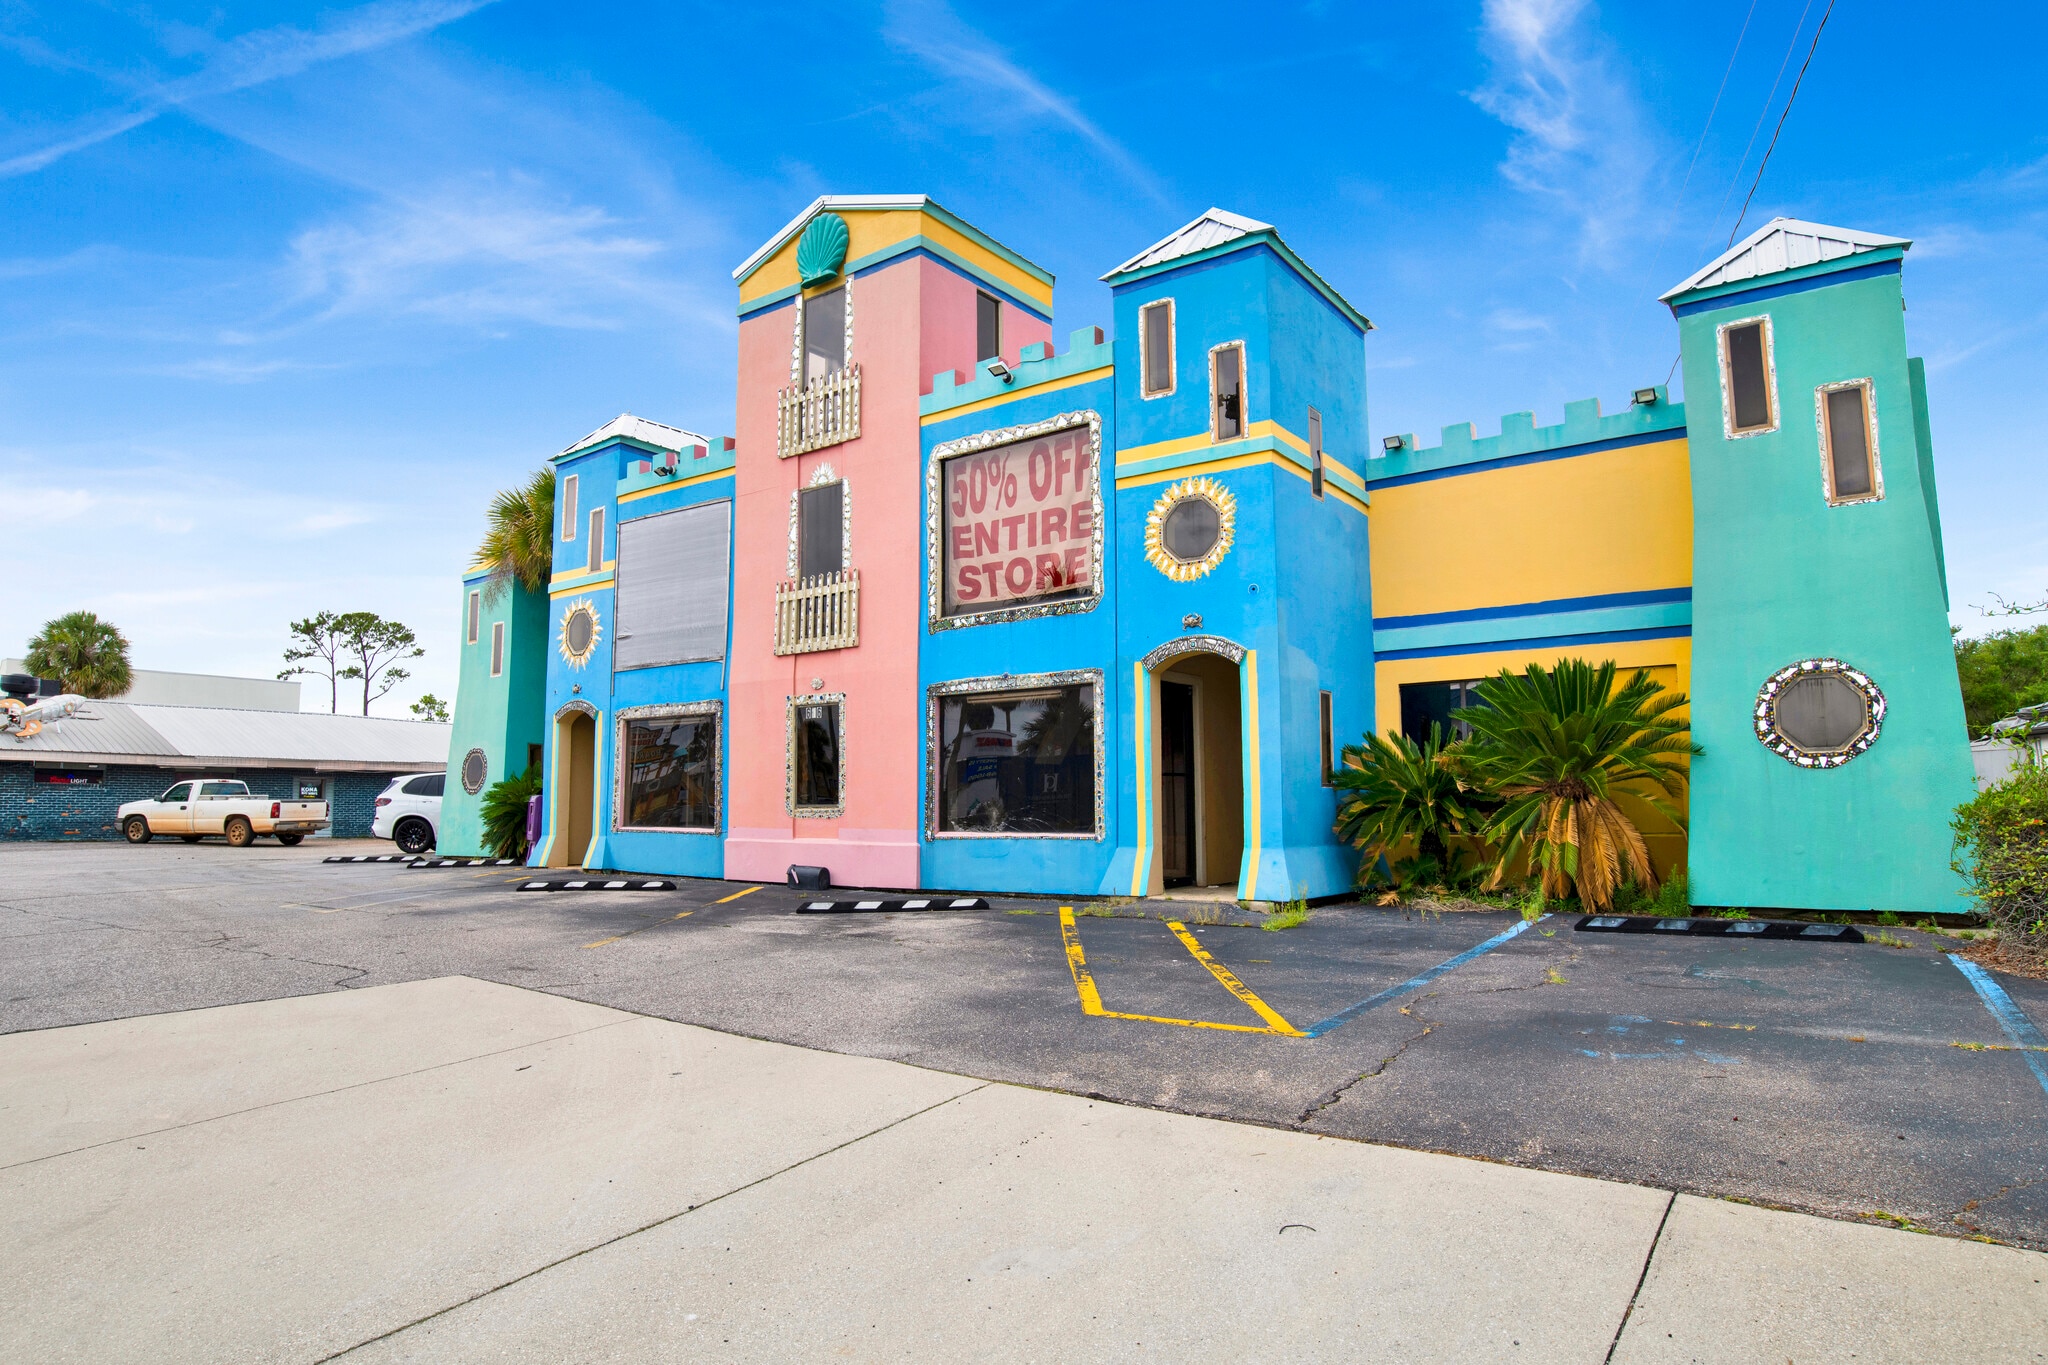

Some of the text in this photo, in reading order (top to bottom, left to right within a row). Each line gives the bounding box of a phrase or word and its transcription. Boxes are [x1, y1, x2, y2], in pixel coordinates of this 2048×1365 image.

[952, 434, 1091, 519] 50% OFF
[952, 500, 1093, 560] ENTIRE
[957, 547, 1088, 600] STORE
[806, 706, 822, 719] 66
